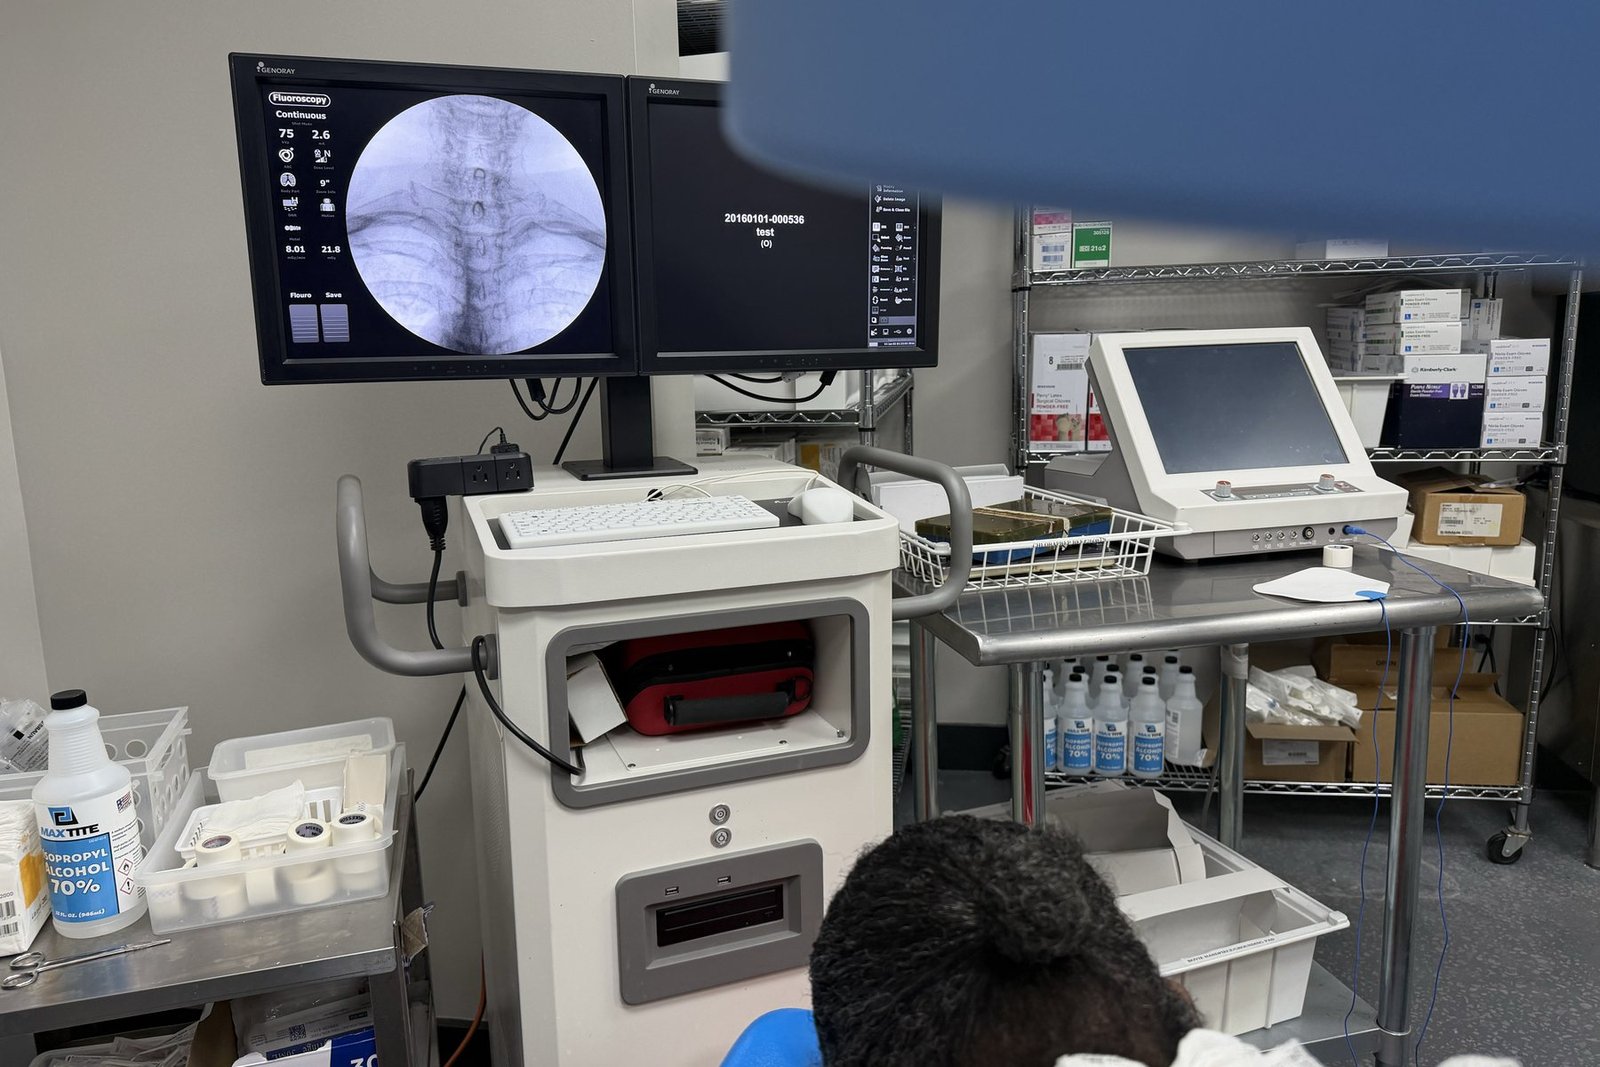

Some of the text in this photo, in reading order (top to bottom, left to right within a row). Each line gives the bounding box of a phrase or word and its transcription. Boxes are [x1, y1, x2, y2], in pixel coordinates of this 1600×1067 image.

[272, 93, 327, 105] Fluoroscopy
[276, 110, 326, 120] Continuous
[279, 128, 294, 138] 75
[312, 130, 330, 139] 2.6
[724, 213, 804, 224] 20160101-000536
[756, 228, 774, 236] test
[1049, 356, 1054, 365] 8
[41, 824, 100, 838] MAXTITE
[45, 862, 110, 877] ALCOHOL
[51, 879, 100, 896] 70%
